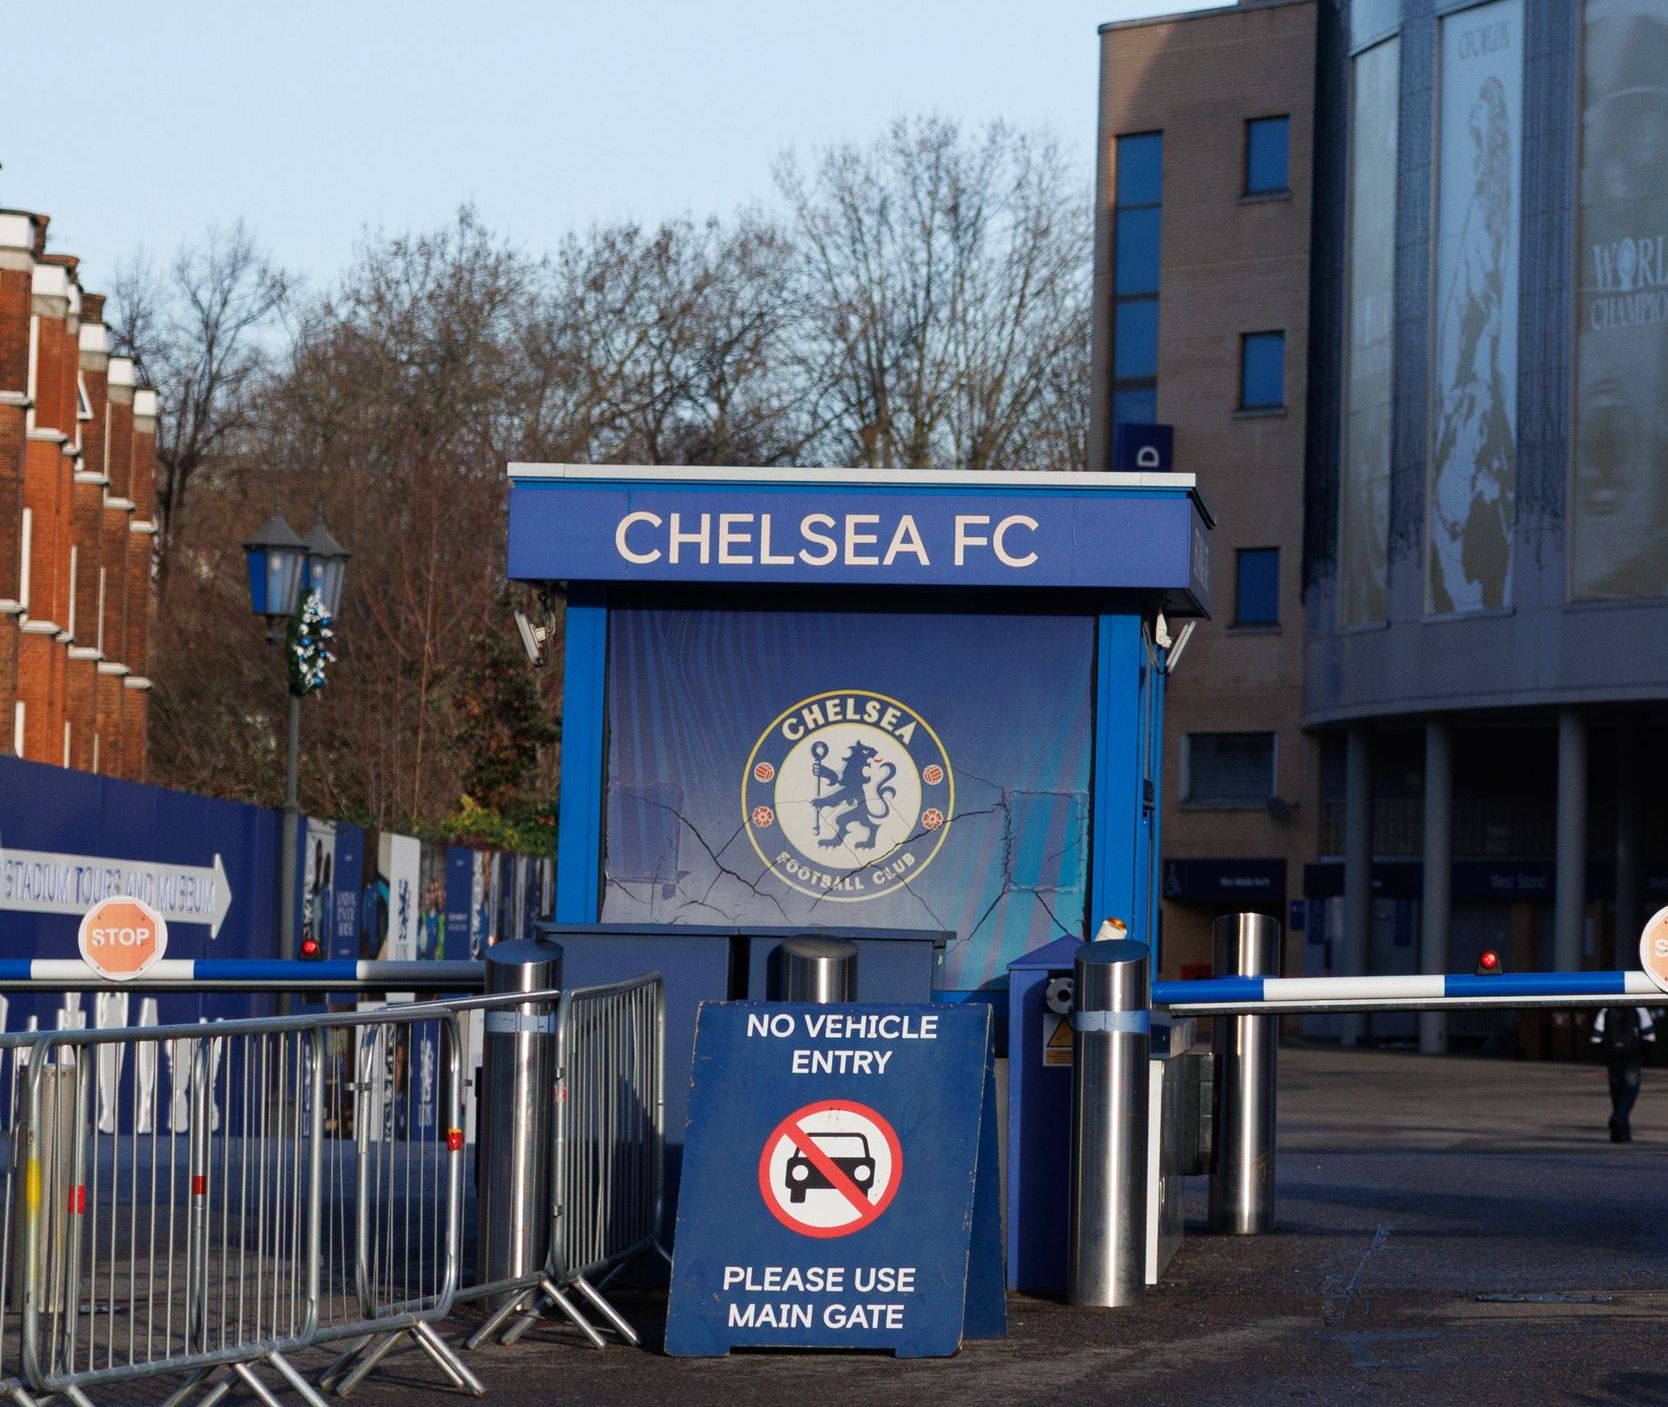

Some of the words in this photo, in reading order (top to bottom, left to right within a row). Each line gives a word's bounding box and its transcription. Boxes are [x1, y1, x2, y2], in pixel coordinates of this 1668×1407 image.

[615, 511, 930, 567] CHELSEA
[954, 515, 1039, 568] FC
[781, 696, 917, 746] CHELSEA
[775, 850, 865, 891] FOOTBALL
[872, 851, 917, 886] CLUB
[5, 858, 71, 902] STADIUM
[75, 865, 121, 906] TOURS
[127, 871, 154, 907] AND
[157, 874, 215, 914] MUSEUM
[92, 927, 150, 947] STOP
[746, 1013, 796, 1039] NO
[804, 1014, 939, 1040] VEHICLE
[791, 1049, 893, 1076] ENTRY
[722, 1265, 844, 1293] PLEASE
[853, 1267, 917, 1293] USE
[727, 1303, 814, 1330] MAIN
[822, 1303, 905, 1331] GATE
